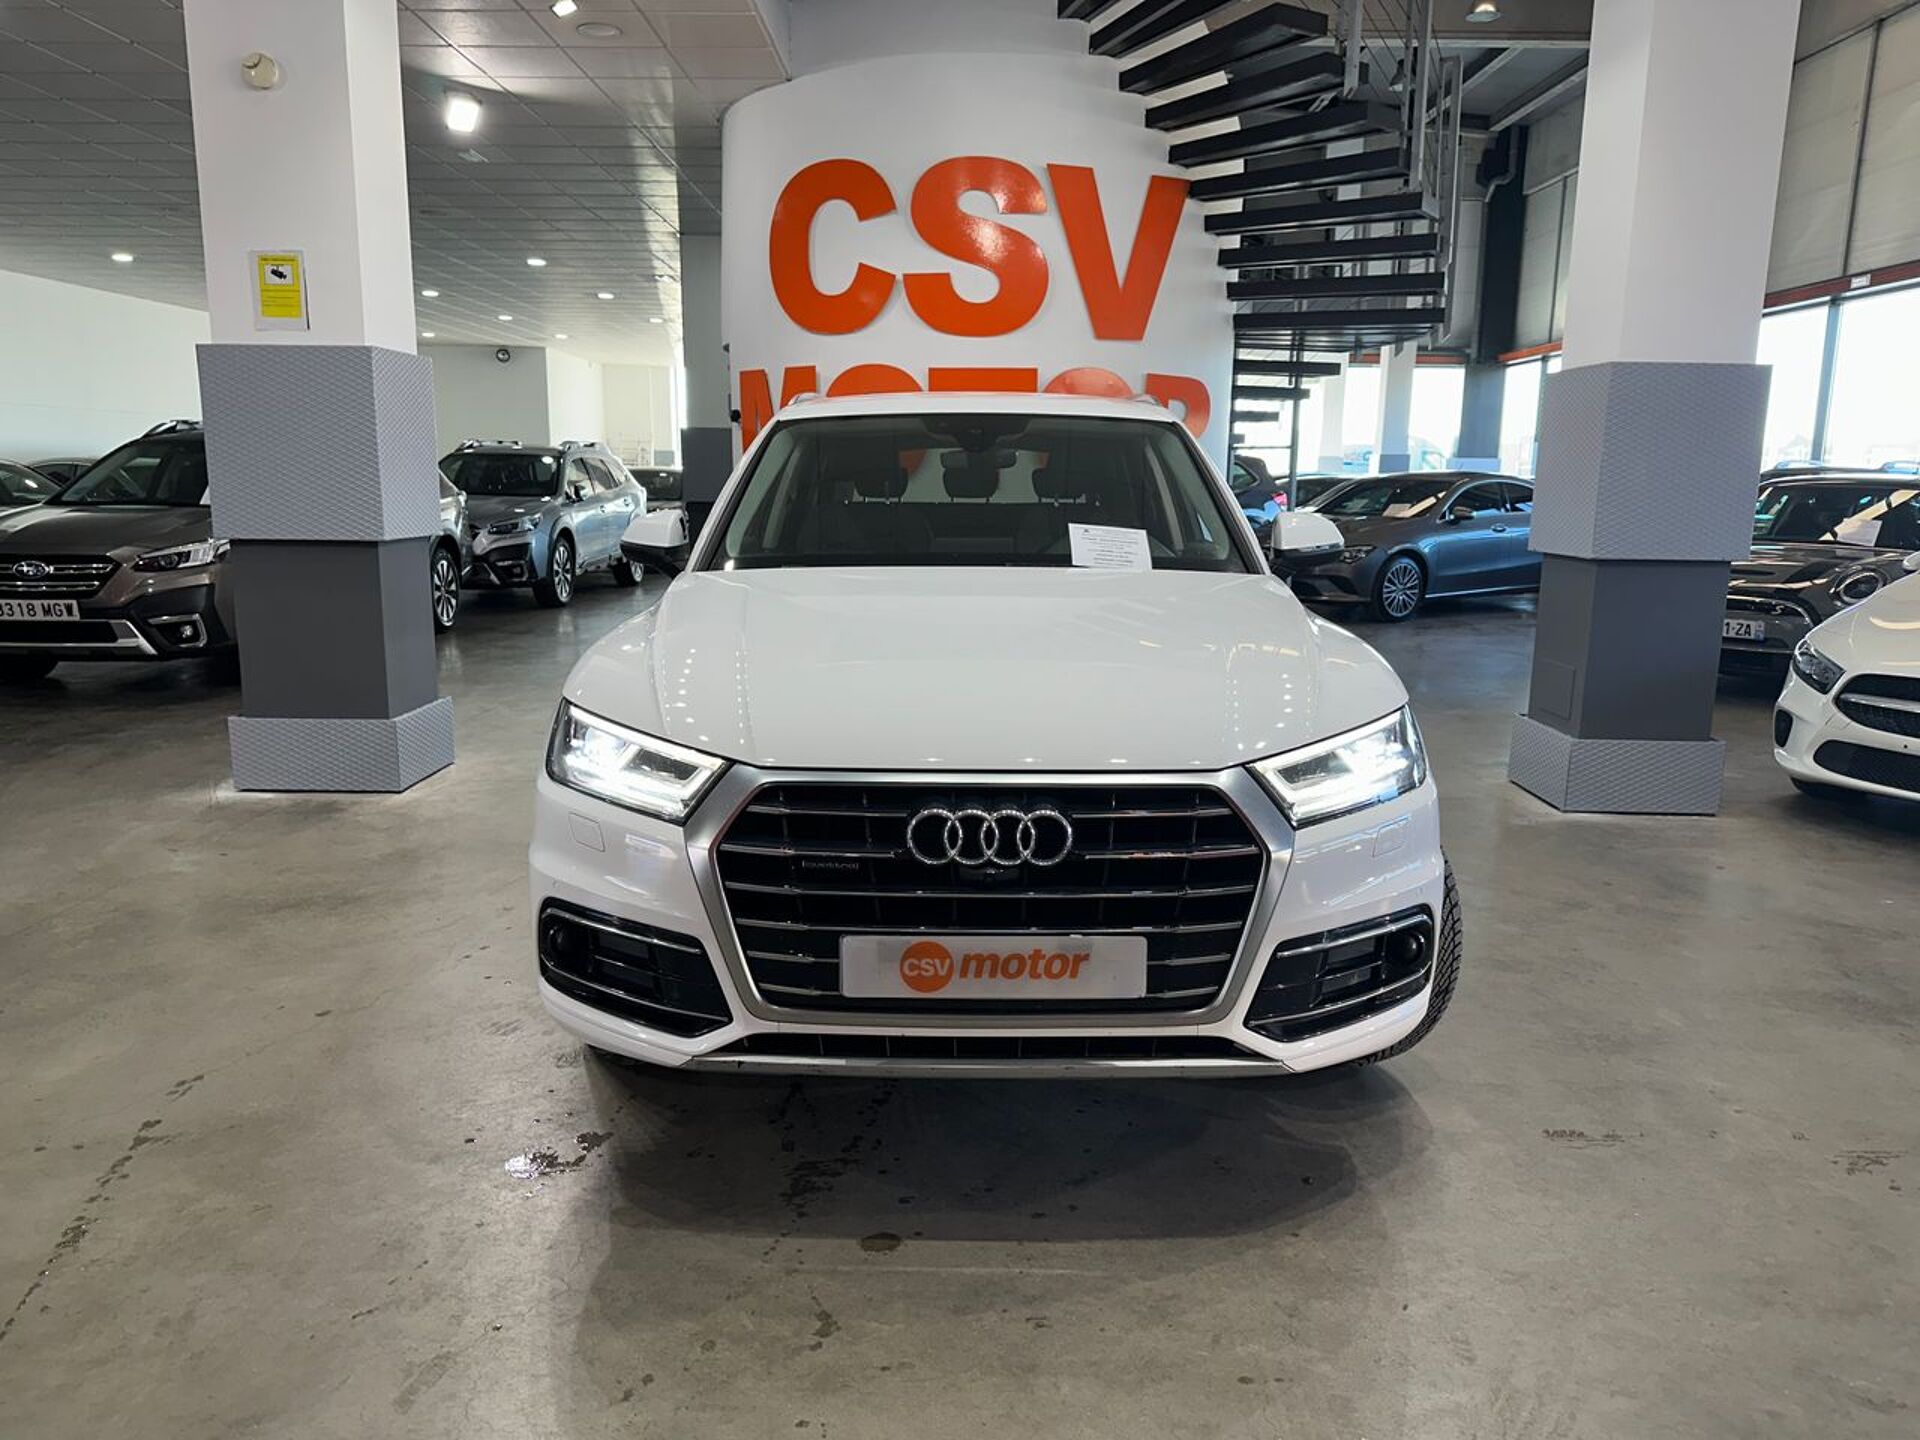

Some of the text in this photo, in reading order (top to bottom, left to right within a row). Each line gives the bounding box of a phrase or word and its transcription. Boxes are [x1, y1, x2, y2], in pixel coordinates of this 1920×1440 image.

[769, 156, 1191, 341] CSV
[41, 602, 75, 618] MGW
[903, 949, 1090, 981] CSV motor
